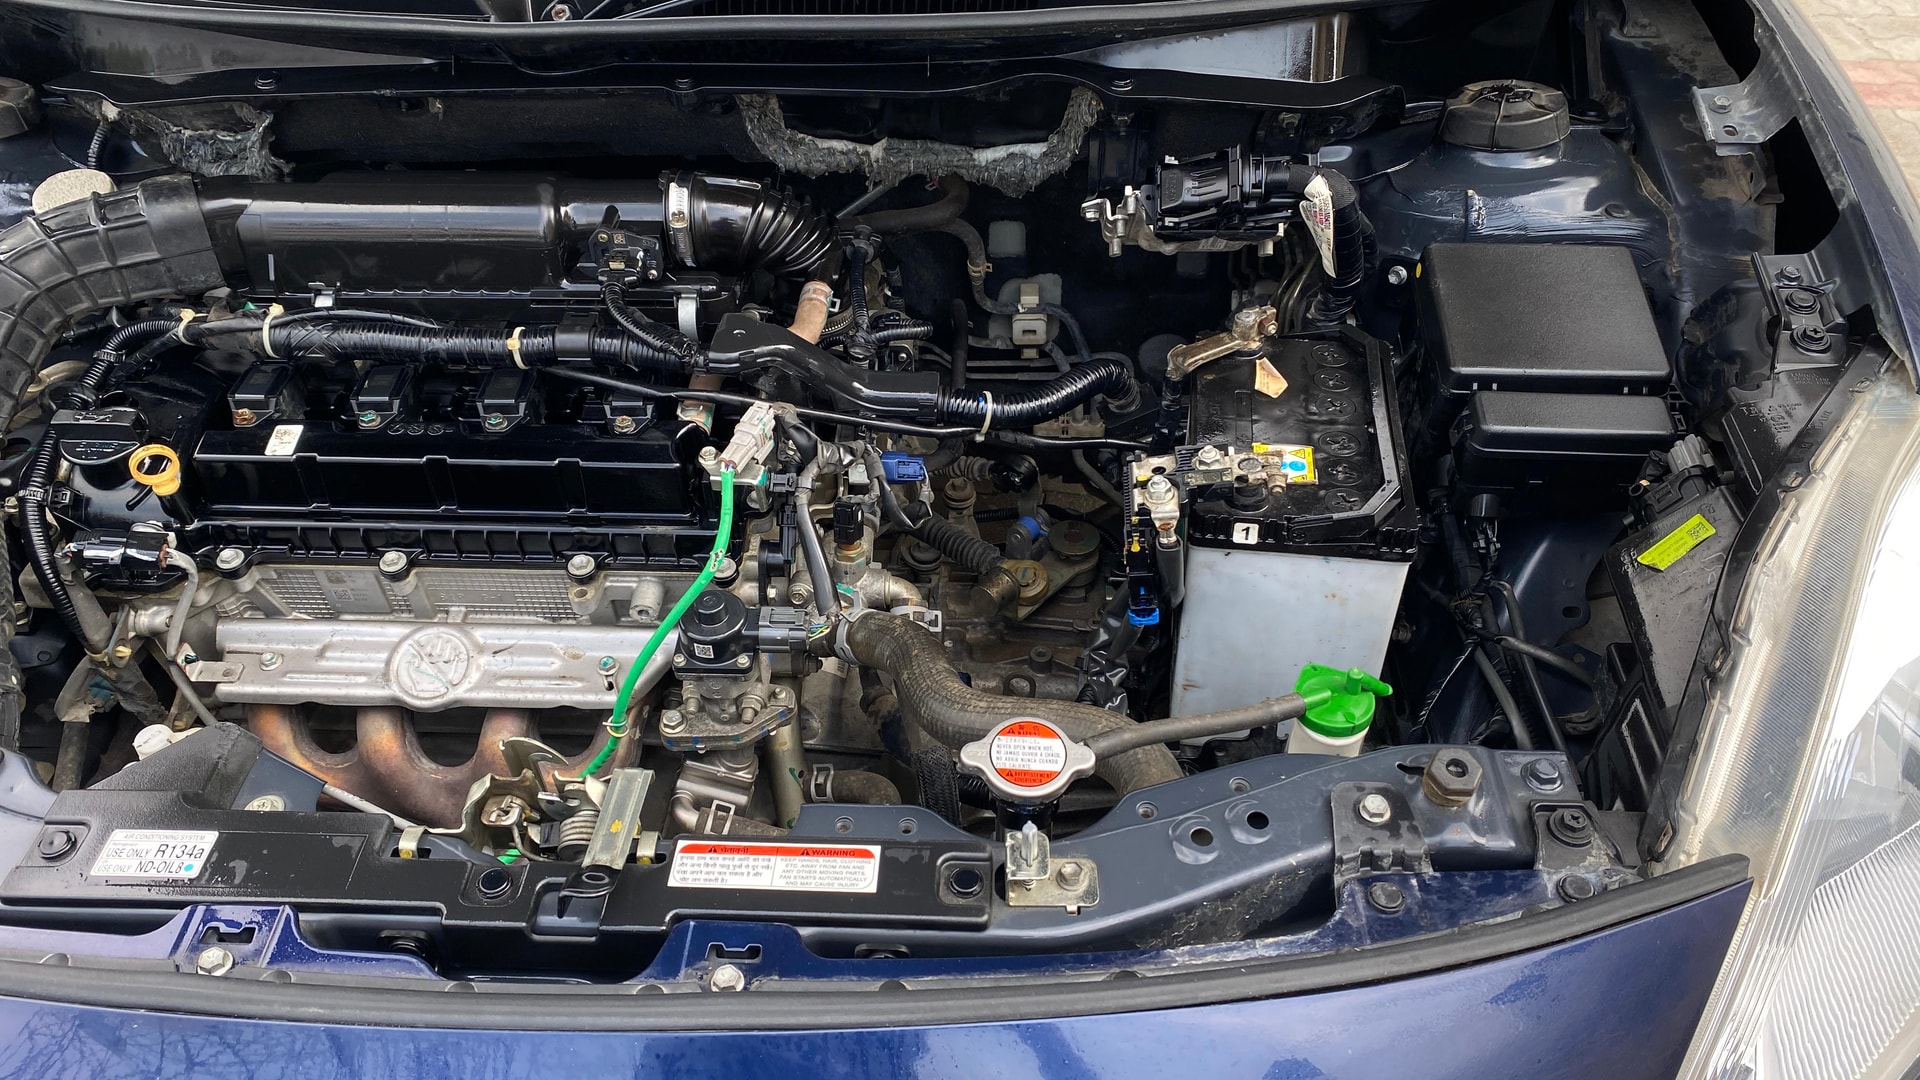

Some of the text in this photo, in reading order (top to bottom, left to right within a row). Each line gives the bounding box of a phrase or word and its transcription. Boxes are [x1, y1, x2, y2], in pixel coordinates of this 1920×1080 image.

[1241, 526, 1250, 540] 1
[106, 844, 205, 858] USE ONLY R134a
[135, 861, 184, 873] ND-OIL8
